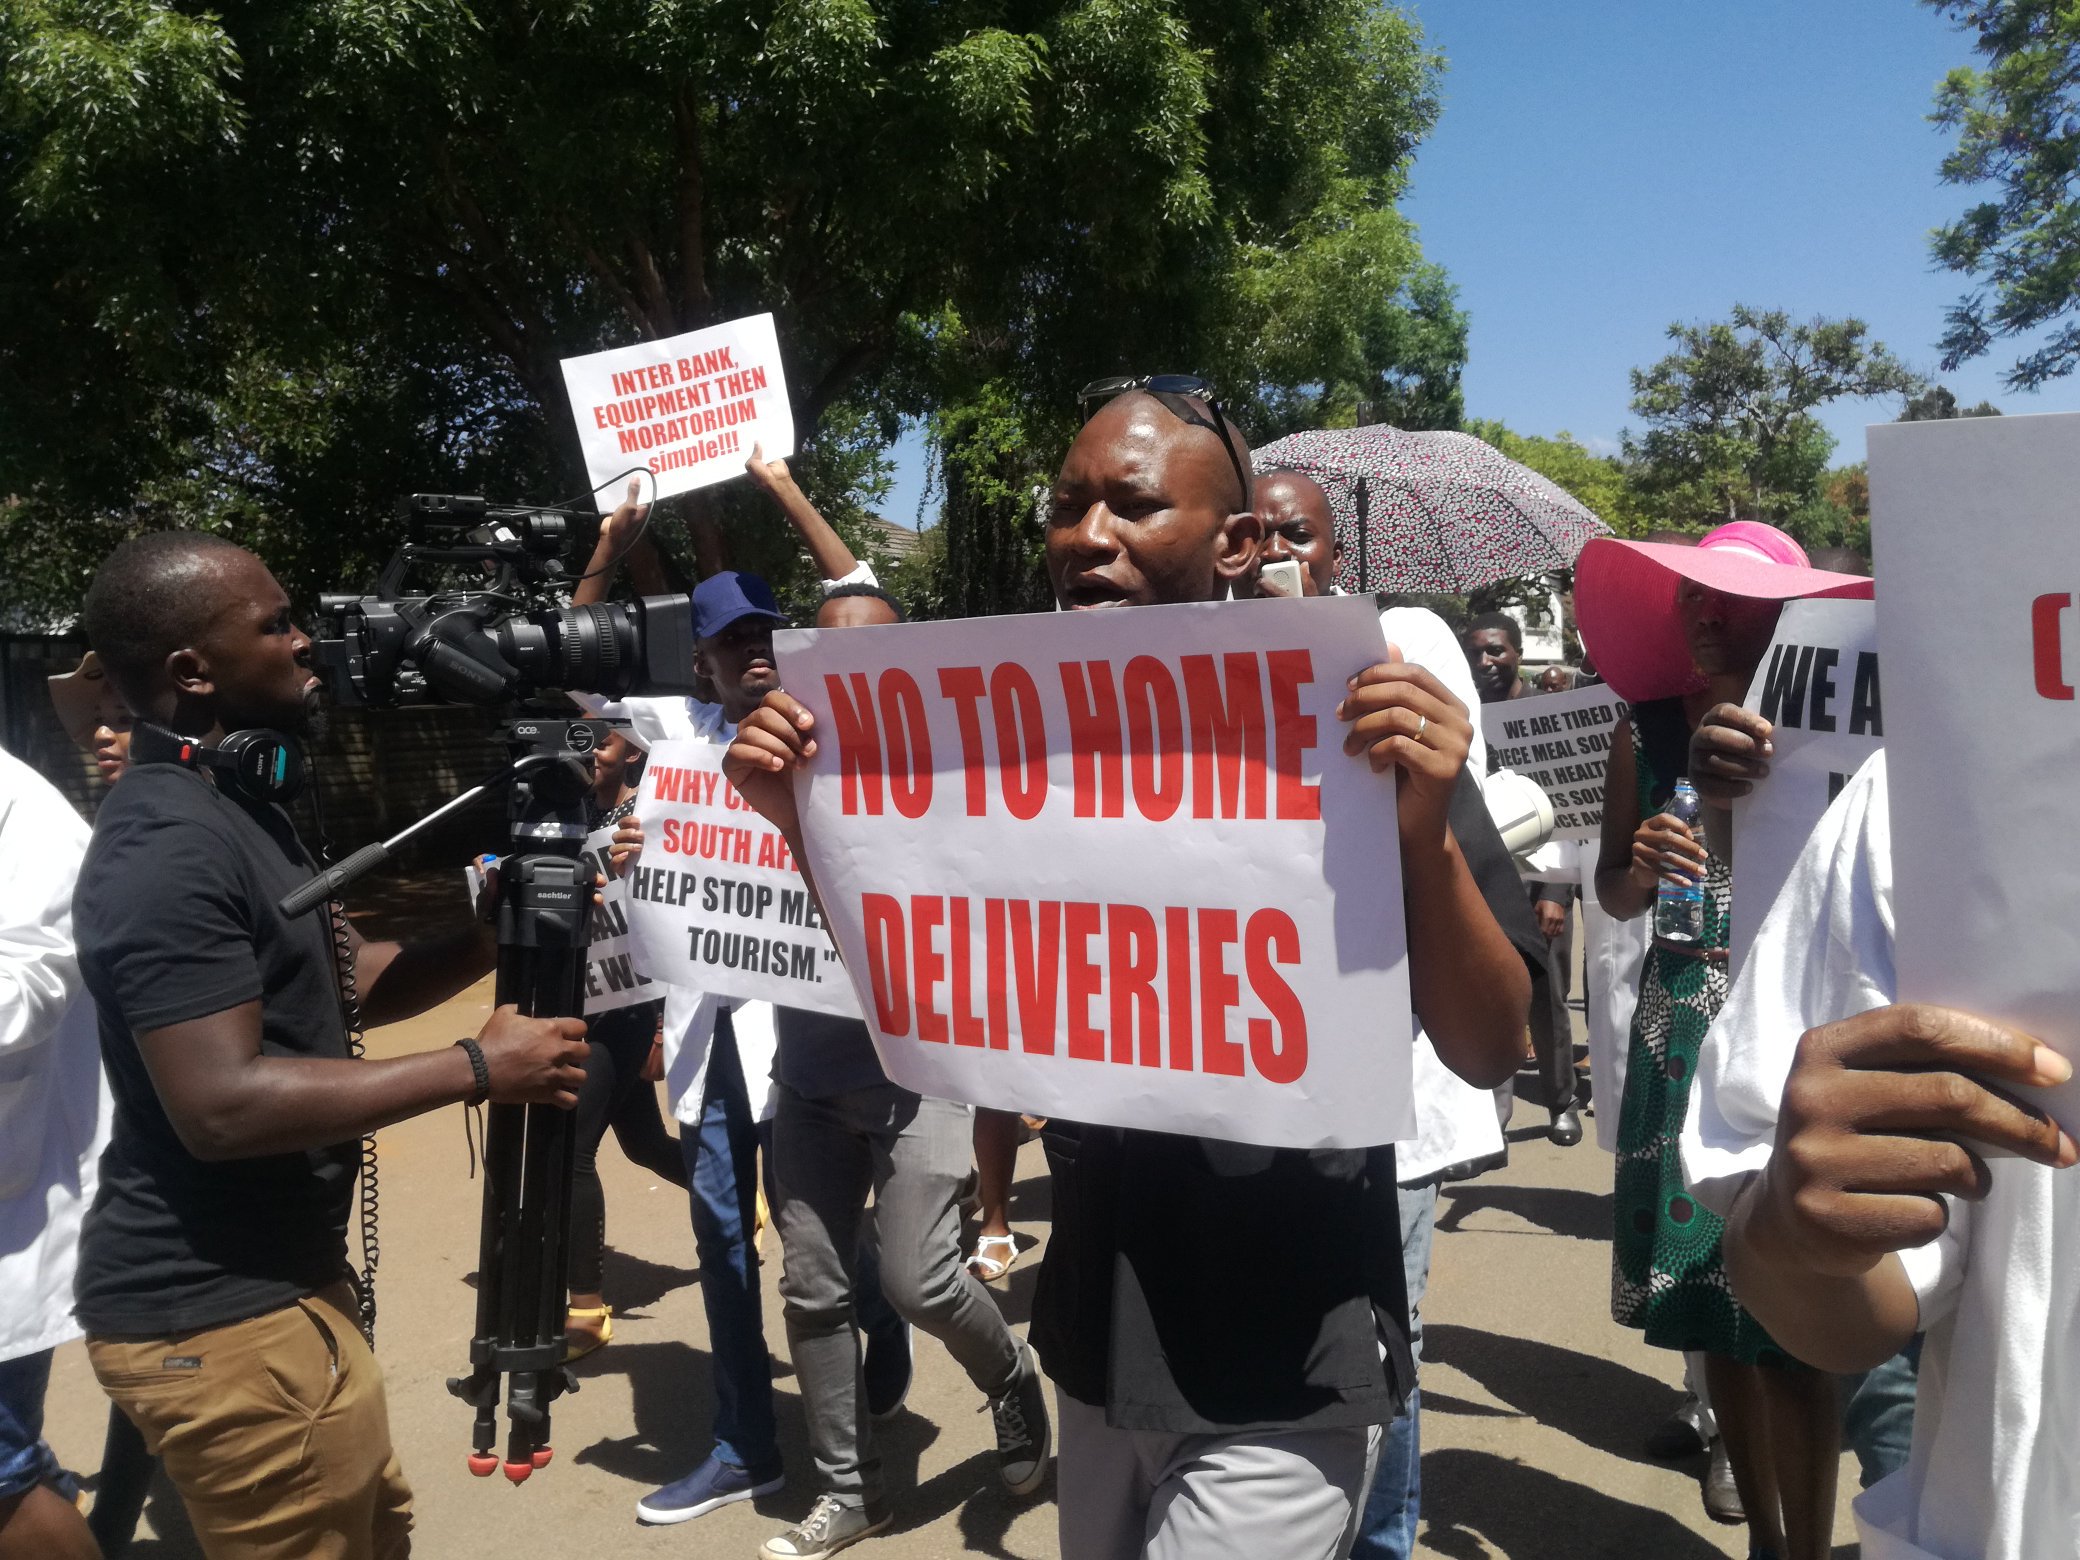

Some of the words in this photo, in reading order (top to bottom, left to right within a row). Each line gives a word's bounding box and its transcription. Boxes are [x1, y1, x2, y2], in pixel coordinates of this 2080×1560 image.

[593, 381, 711, 430] EQUIPMENT
[715, 365, 768, 399] THEN
[611, 363, 675, 397] INTER
[677, 346, 739, 382] BANK,
[617, 398, 757, 454] MORATORIUM
[648, 430, 740, 475] simple!!!
[450, 660, 485, 683] SONY
[2032, 592, 2080, 701] C
[1759, 643, 1839, 733] WE
[517, 726, 538, 735] ace
[823, 667, 934, 819] NO
[937, 661, 1049, 821] TO
[1058, 648, 1322, 822] HOME
[1503, 720, 1529, 739] WE
[1530, 714, 1562, 736] ARE
[1561, 704, 1614, 730] TIRED
[1531, 739, 1577, 763] MEAL
[648, 765, 720, 806] "WHY
[662, 818, 753, 865] SOUTH
[757, 832, 801, 872] AF
[537, 891, 572, 900] sachtler
[632, 865, 697, 907] HELP
[702, 876, 773, 920] STOP
[779, 887, 825, 930] ME
[687, 925, 837, 984] TOURISM."
[861, 892, 1309, 1085] DELIVERIES
